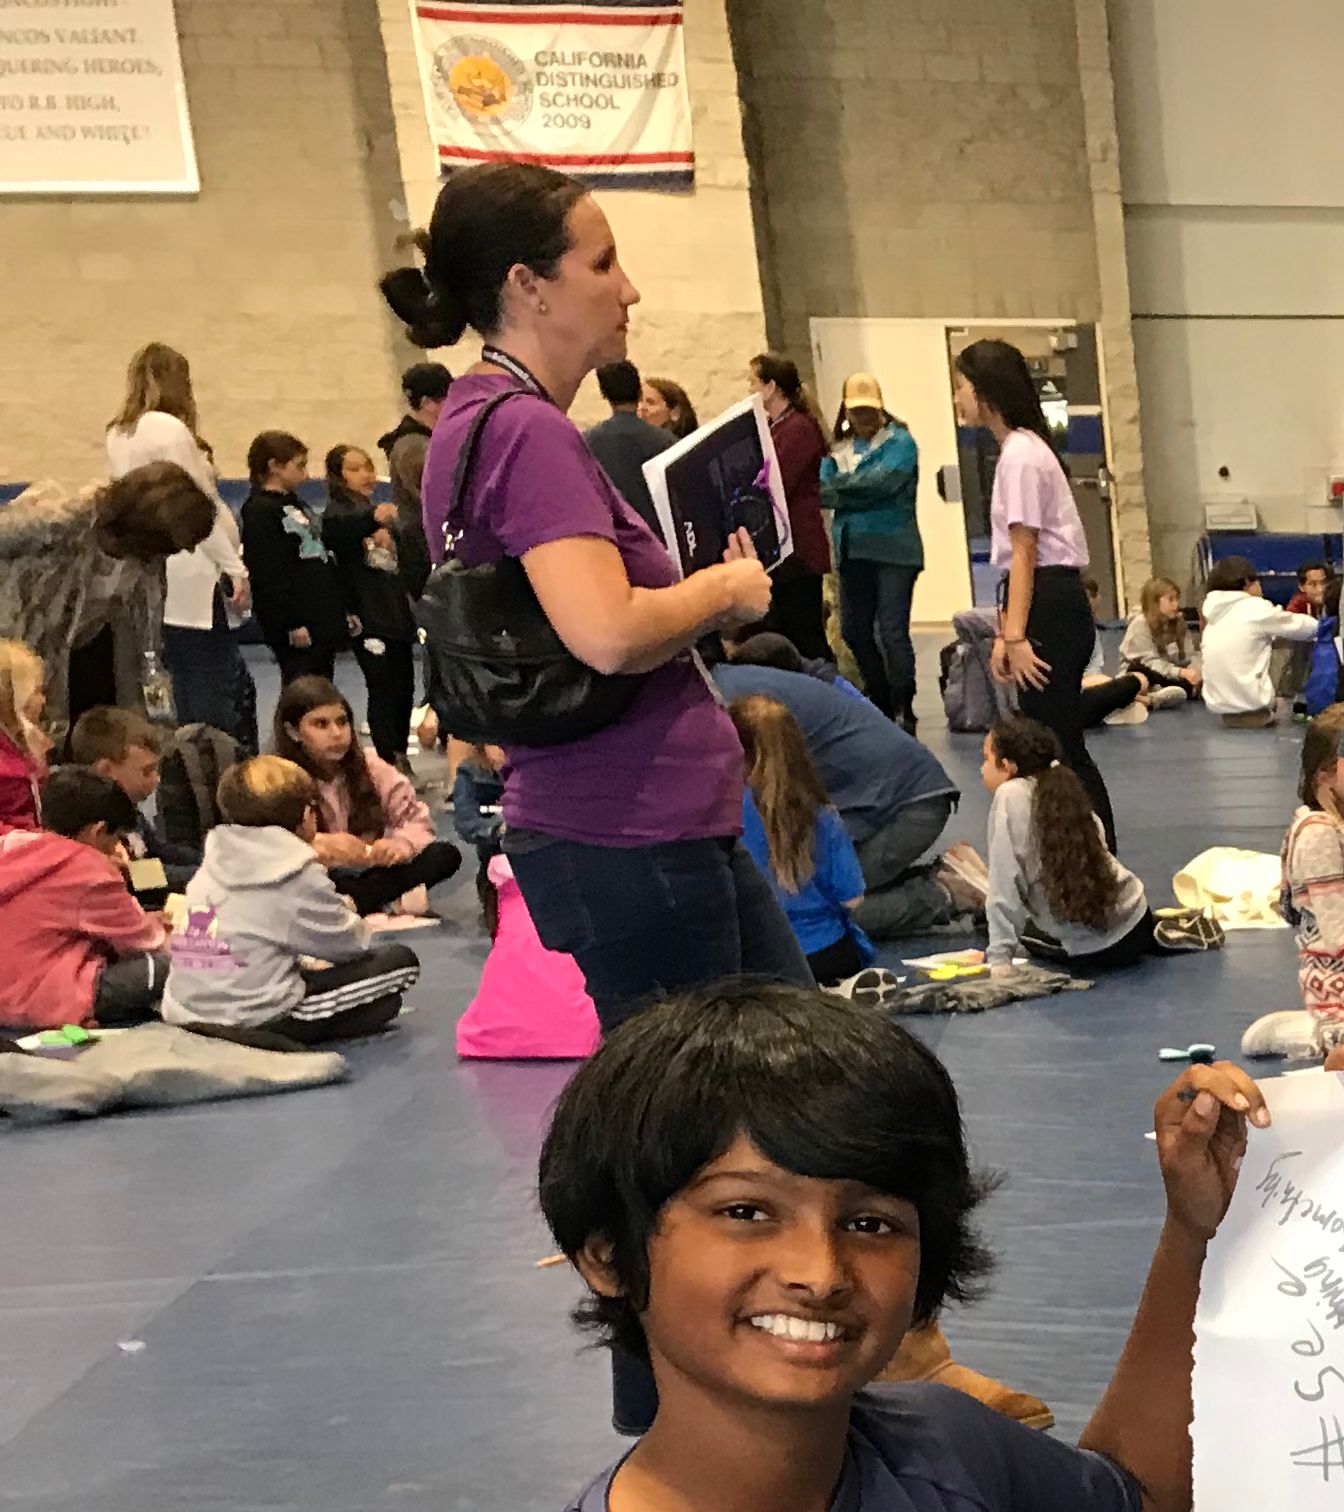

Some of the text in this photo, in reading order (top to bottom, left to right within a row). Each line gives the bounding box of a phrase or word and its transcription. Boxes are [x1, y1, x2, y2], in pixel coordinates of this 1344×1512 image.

[534, 51, 648, 68] CALIFORNIA
[535, 71, 679, 88] DISTINGUISHED
[539, 92, 621, 110] SCHOOL
[541, 114, 592, 129] 2009
